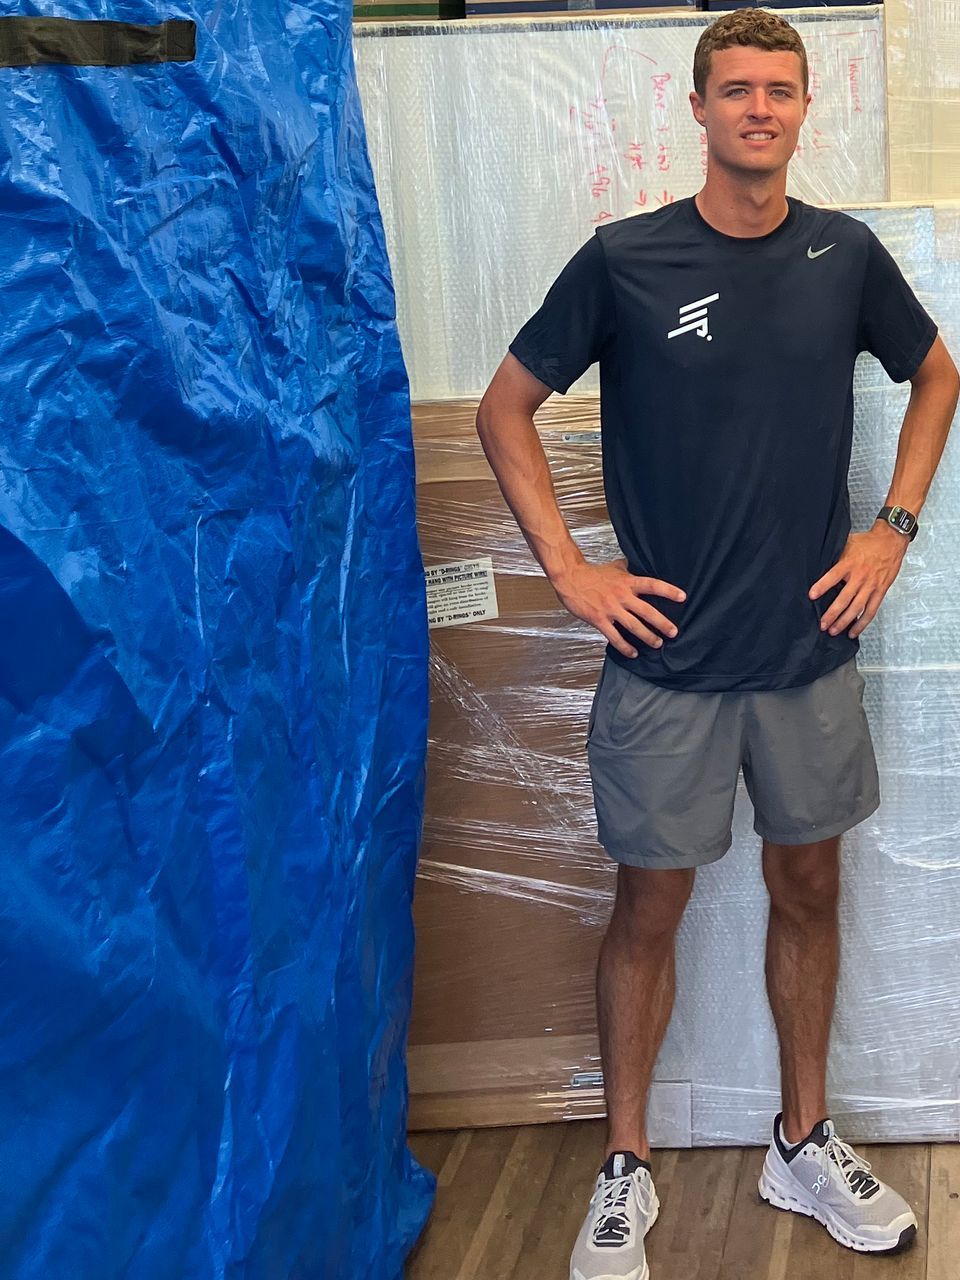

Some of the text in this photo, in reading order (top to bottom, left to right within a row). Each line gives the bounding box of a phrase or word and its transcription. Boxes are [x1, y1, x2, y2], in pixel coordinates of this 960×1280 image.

[454, 572, 473, 581] PICTURE
[445, 611, 472, 621] "D-RINGS"
[472, 609, 486, 617] ONLY
